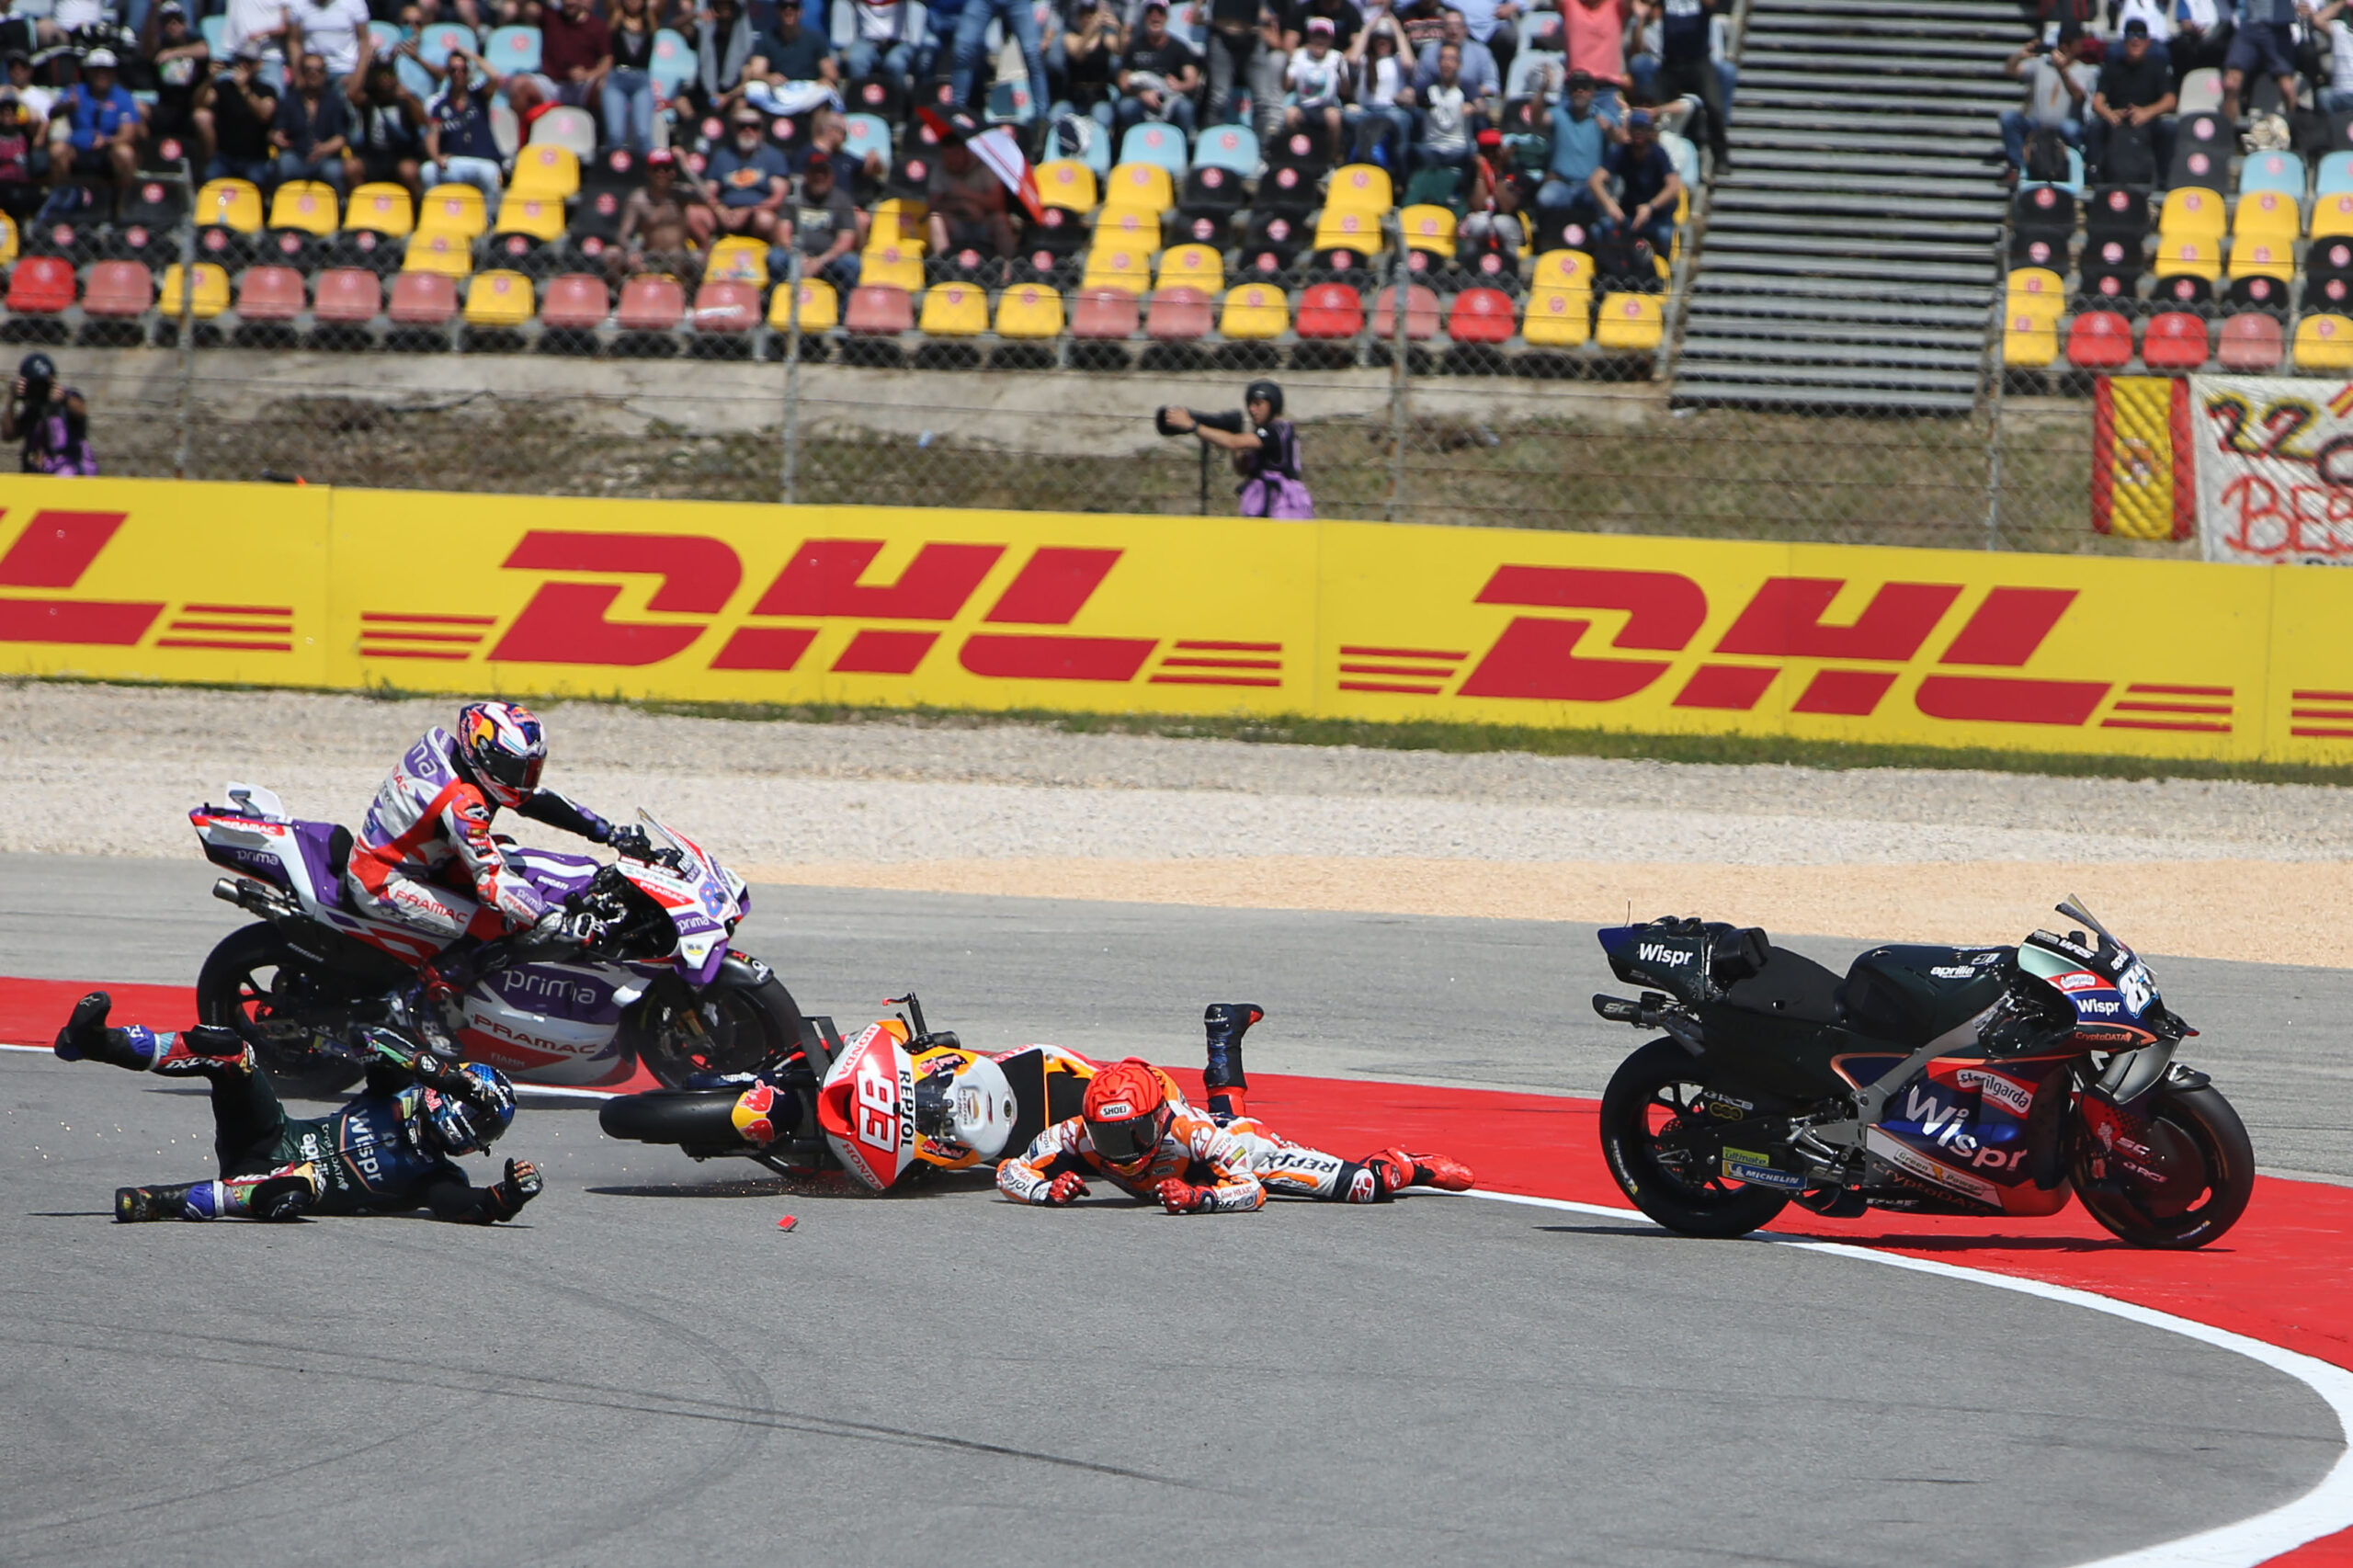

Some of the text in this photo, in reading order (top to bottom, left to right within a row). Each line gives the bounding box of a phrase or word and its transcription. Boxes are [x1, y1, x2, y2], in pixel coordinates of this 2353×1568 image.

[485, 530, 1161, 681] DHL
[1456, 563, 2113, 726] DHL
[235, 848, 279, 866] prima
[394, 890, 469, 925] PRAMAC
[676, 916, 710, 935] prima
[1639, 943, 1693, 968] Wispr
[1930, 964, 1976, 977] aprilia
[502, 970, 597, 1005] prima
[2076, 998, 2121, 1017] Wispr
[473, 1013, 597, 1054] PRAMAC
[837, 1026, 879, 1076] HONDA
[2075, 1031, 2127, 1042] CryptoDATA
[1959, 1072, 2029, 1108] sterilgarda
[856, 1070, 896, 1153] 93
[898, 1069, 915, 1148] REPSOL
[1102, 1106, 1128, 1117] SHOEI
[347, 1108, 384, 1182] Wispr
[1905, 1085, 2029, 1172] Wispr
[841, 1142, 884, 1191] HONDA
[1724, 1150, 1767, 1165] ultimate
[1898, 1152, 1929, 1172] Green
[1745, 1168, 1800, 1185] MICHELIN
[1871, 1160, 1991, 1214] CryptoDATA
